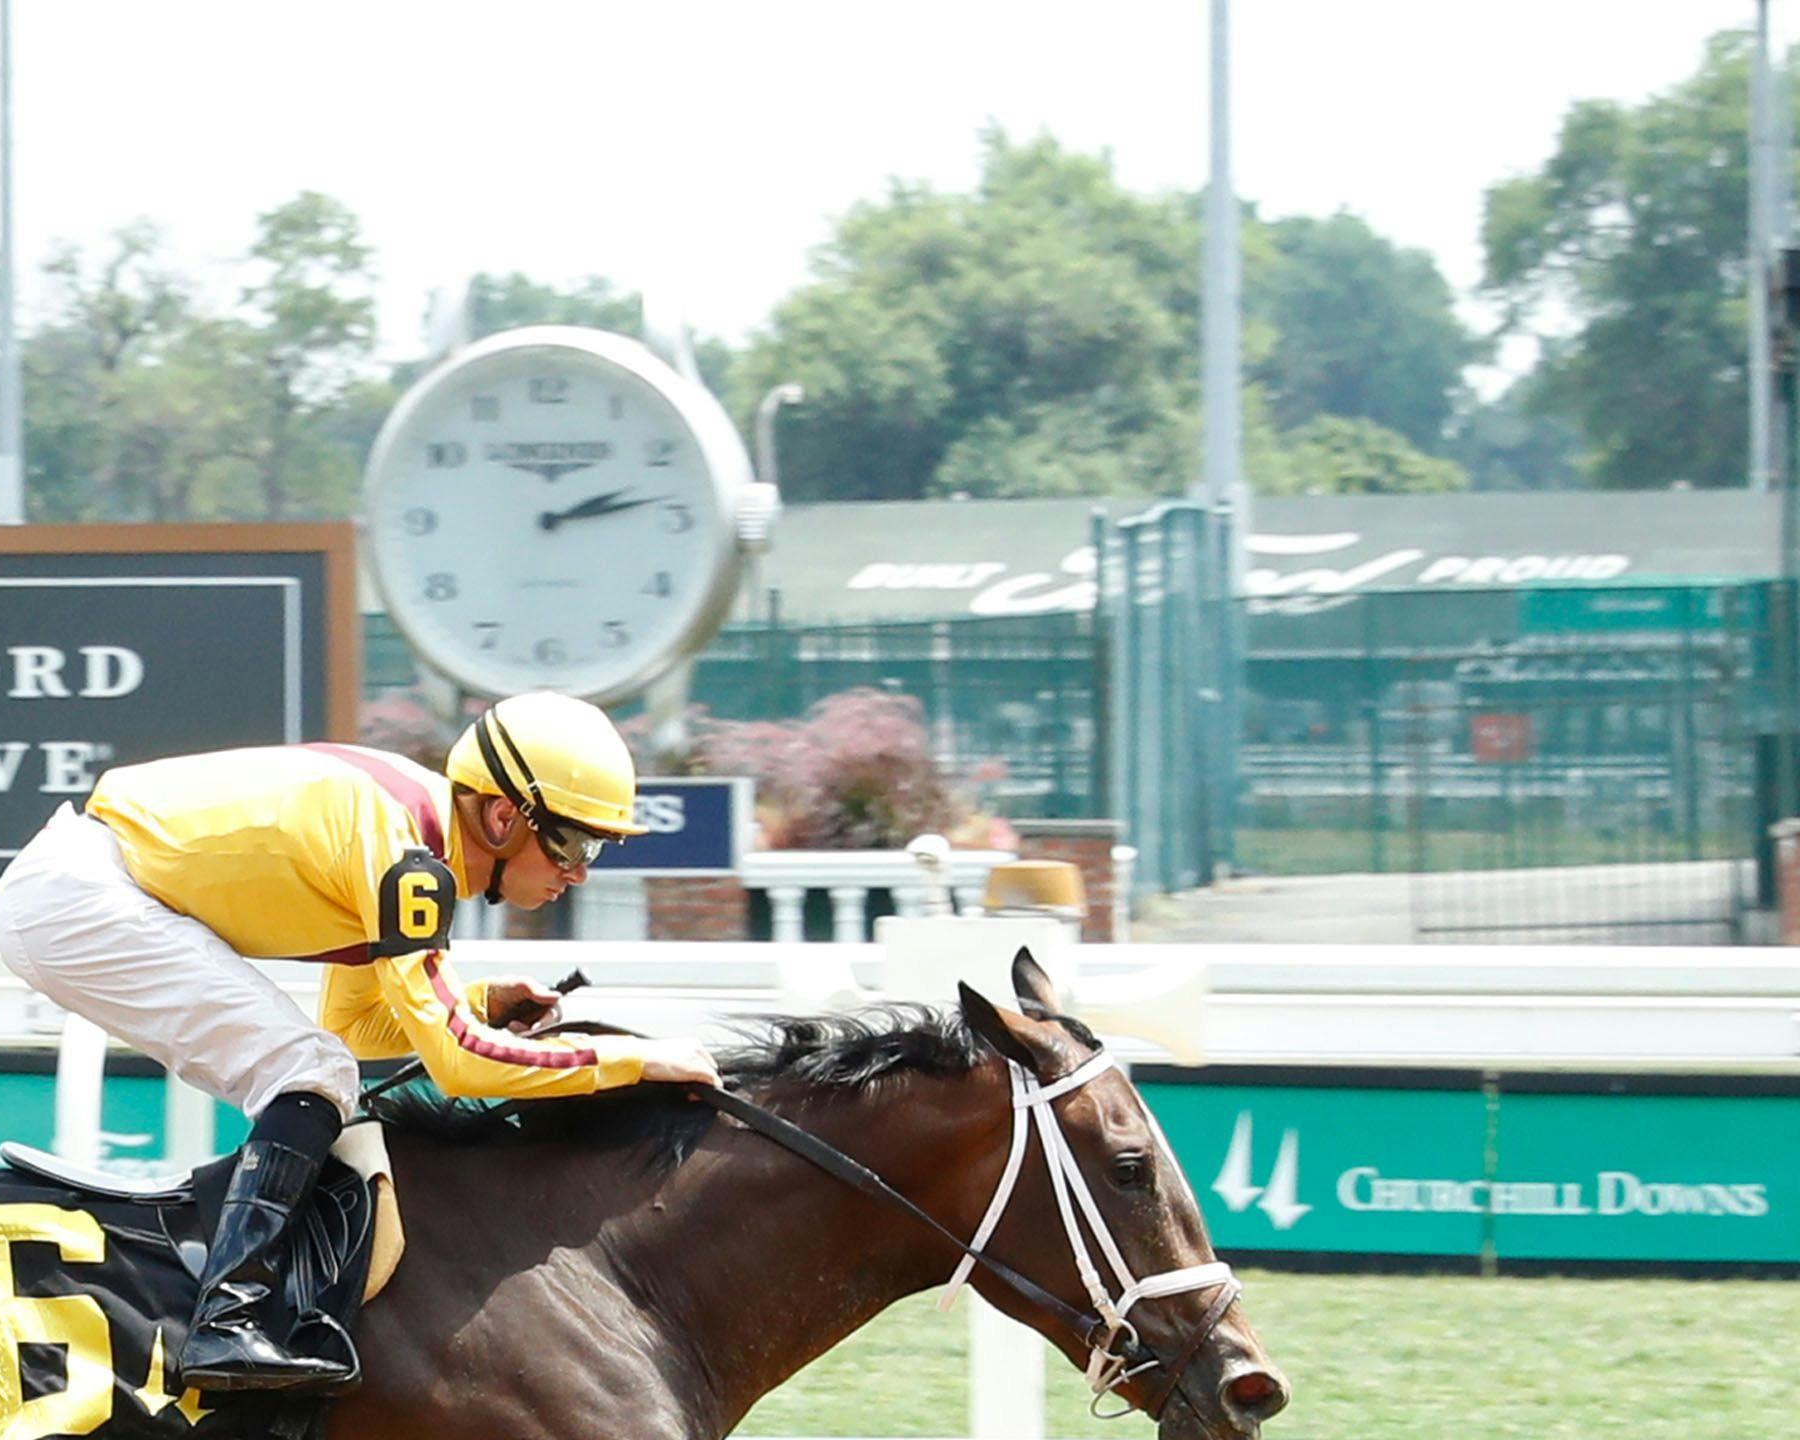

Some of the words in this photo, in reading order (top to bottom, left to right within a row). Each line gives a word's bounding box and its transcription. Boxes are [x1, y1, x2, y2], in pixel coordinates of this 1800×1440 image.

[404, 506, 438, 537] 9
[424, 571, 458, 601] 8
[398, 871, 439, 939] 6
[1336, 1166, 1591, 1215] CHURCHILL
[1596, 1170, 1769, 1216] DOWNS
